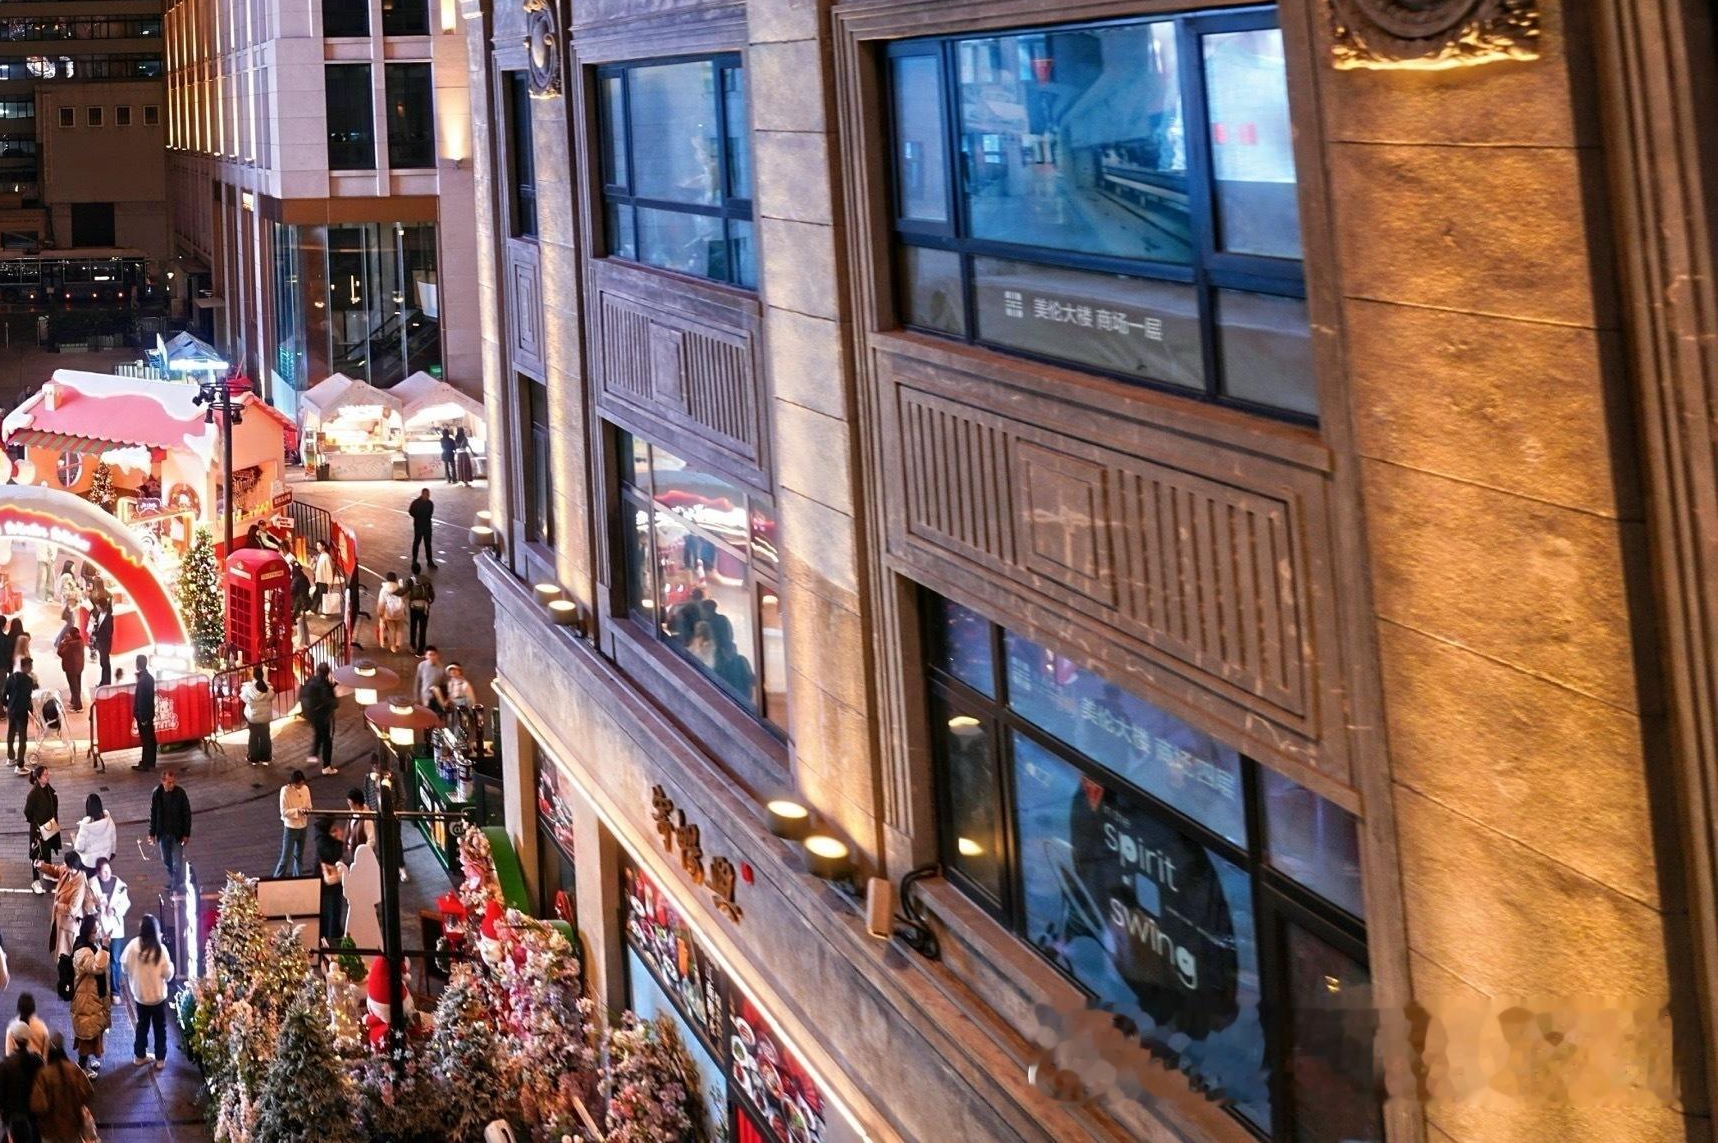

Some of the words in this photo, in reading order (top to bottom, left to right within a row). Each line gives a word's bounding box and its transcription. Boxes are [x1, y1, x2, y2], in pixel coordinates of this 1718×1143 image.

[1033, 299, 1093, 328] 美伦大楼
[1096, 309, 1163, 341] 商场一层
[1110, 898, 1198, 990] swing
